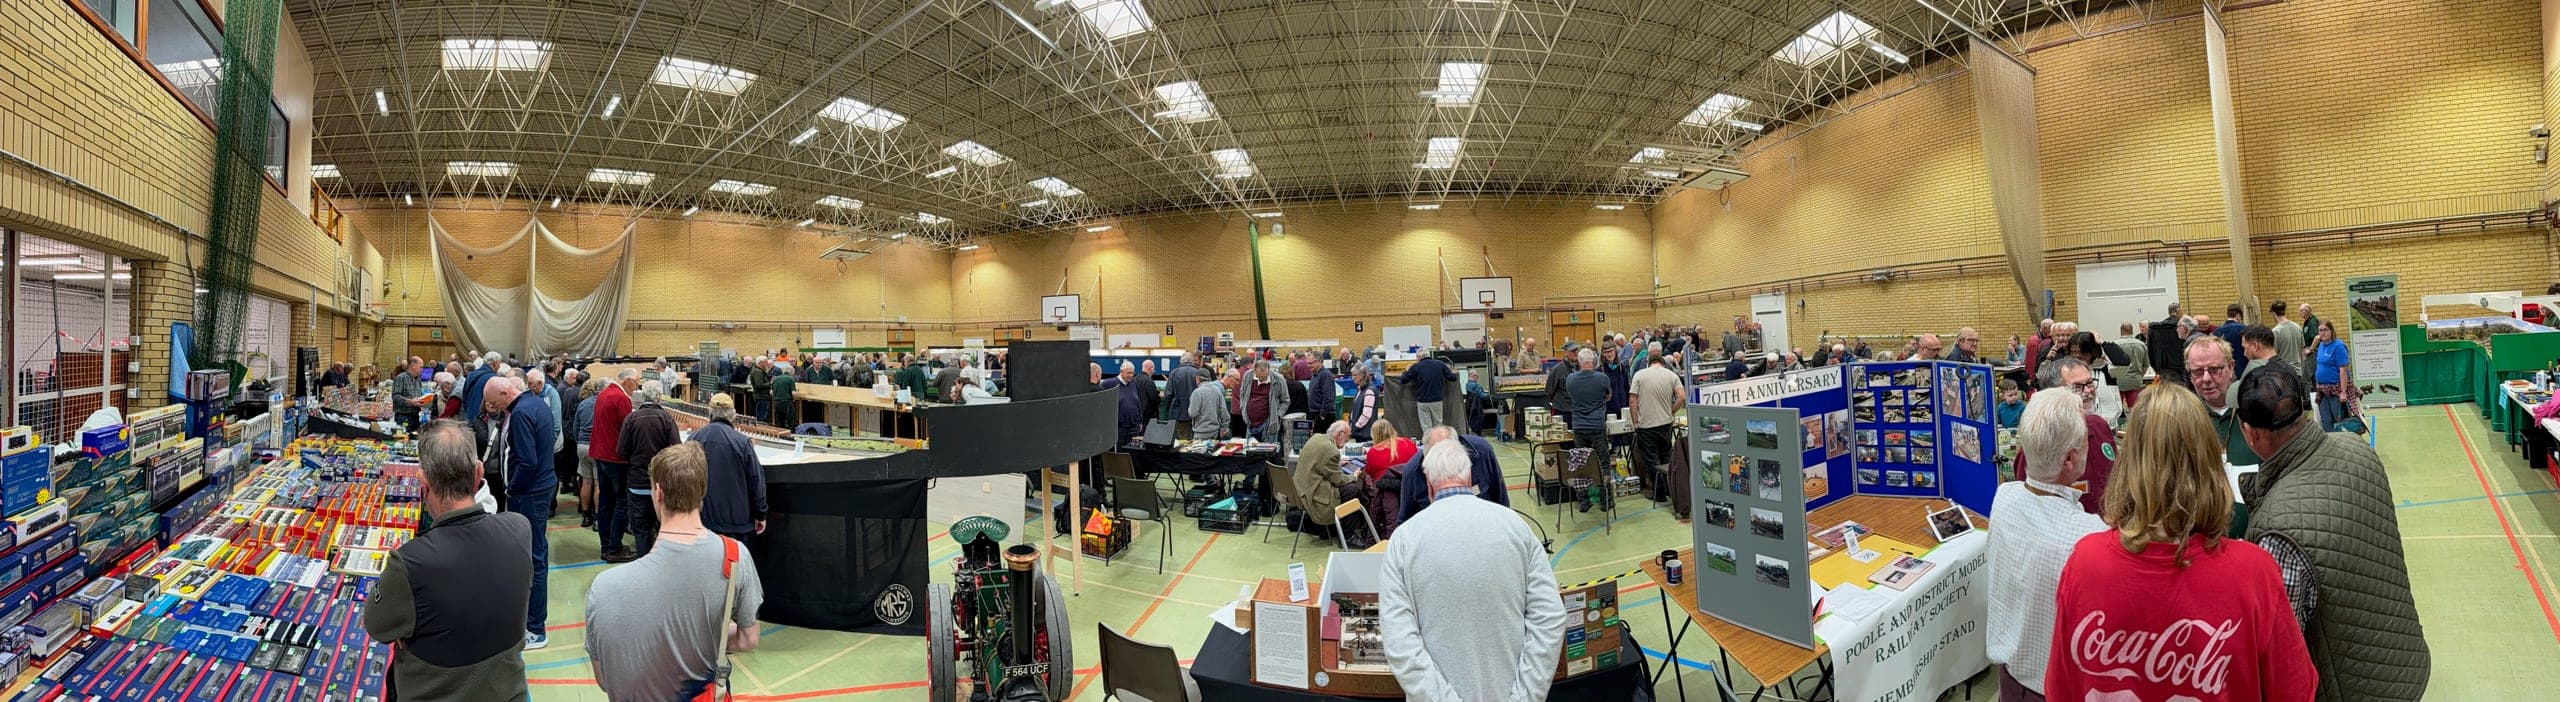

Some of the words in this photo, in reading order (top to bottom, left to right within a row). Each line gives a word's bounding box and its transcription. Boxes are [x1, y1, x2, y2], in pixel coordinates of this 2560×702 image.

[1703, 388, 1740, 405] 70TH
[881, 590, 907, 617] MRS
[1845, 622, 1886, 664] POOLE
[1890, 604, 1912, 632] AND
[1915, 570, 1957, 612] DISTRICT
[1958, 552, 1988, 580] MODEL
[1929, 581, 1971, 621] SOCIETY
[1005, 669, 1011, 677] F
[1030, 664, 1049, 675] UCF
[1873, 643, 1938, 702] EMBSHIP
[1940, 620, 1976, 650] STAND
[2070, 610, 2242, 695] Coca-Cola
